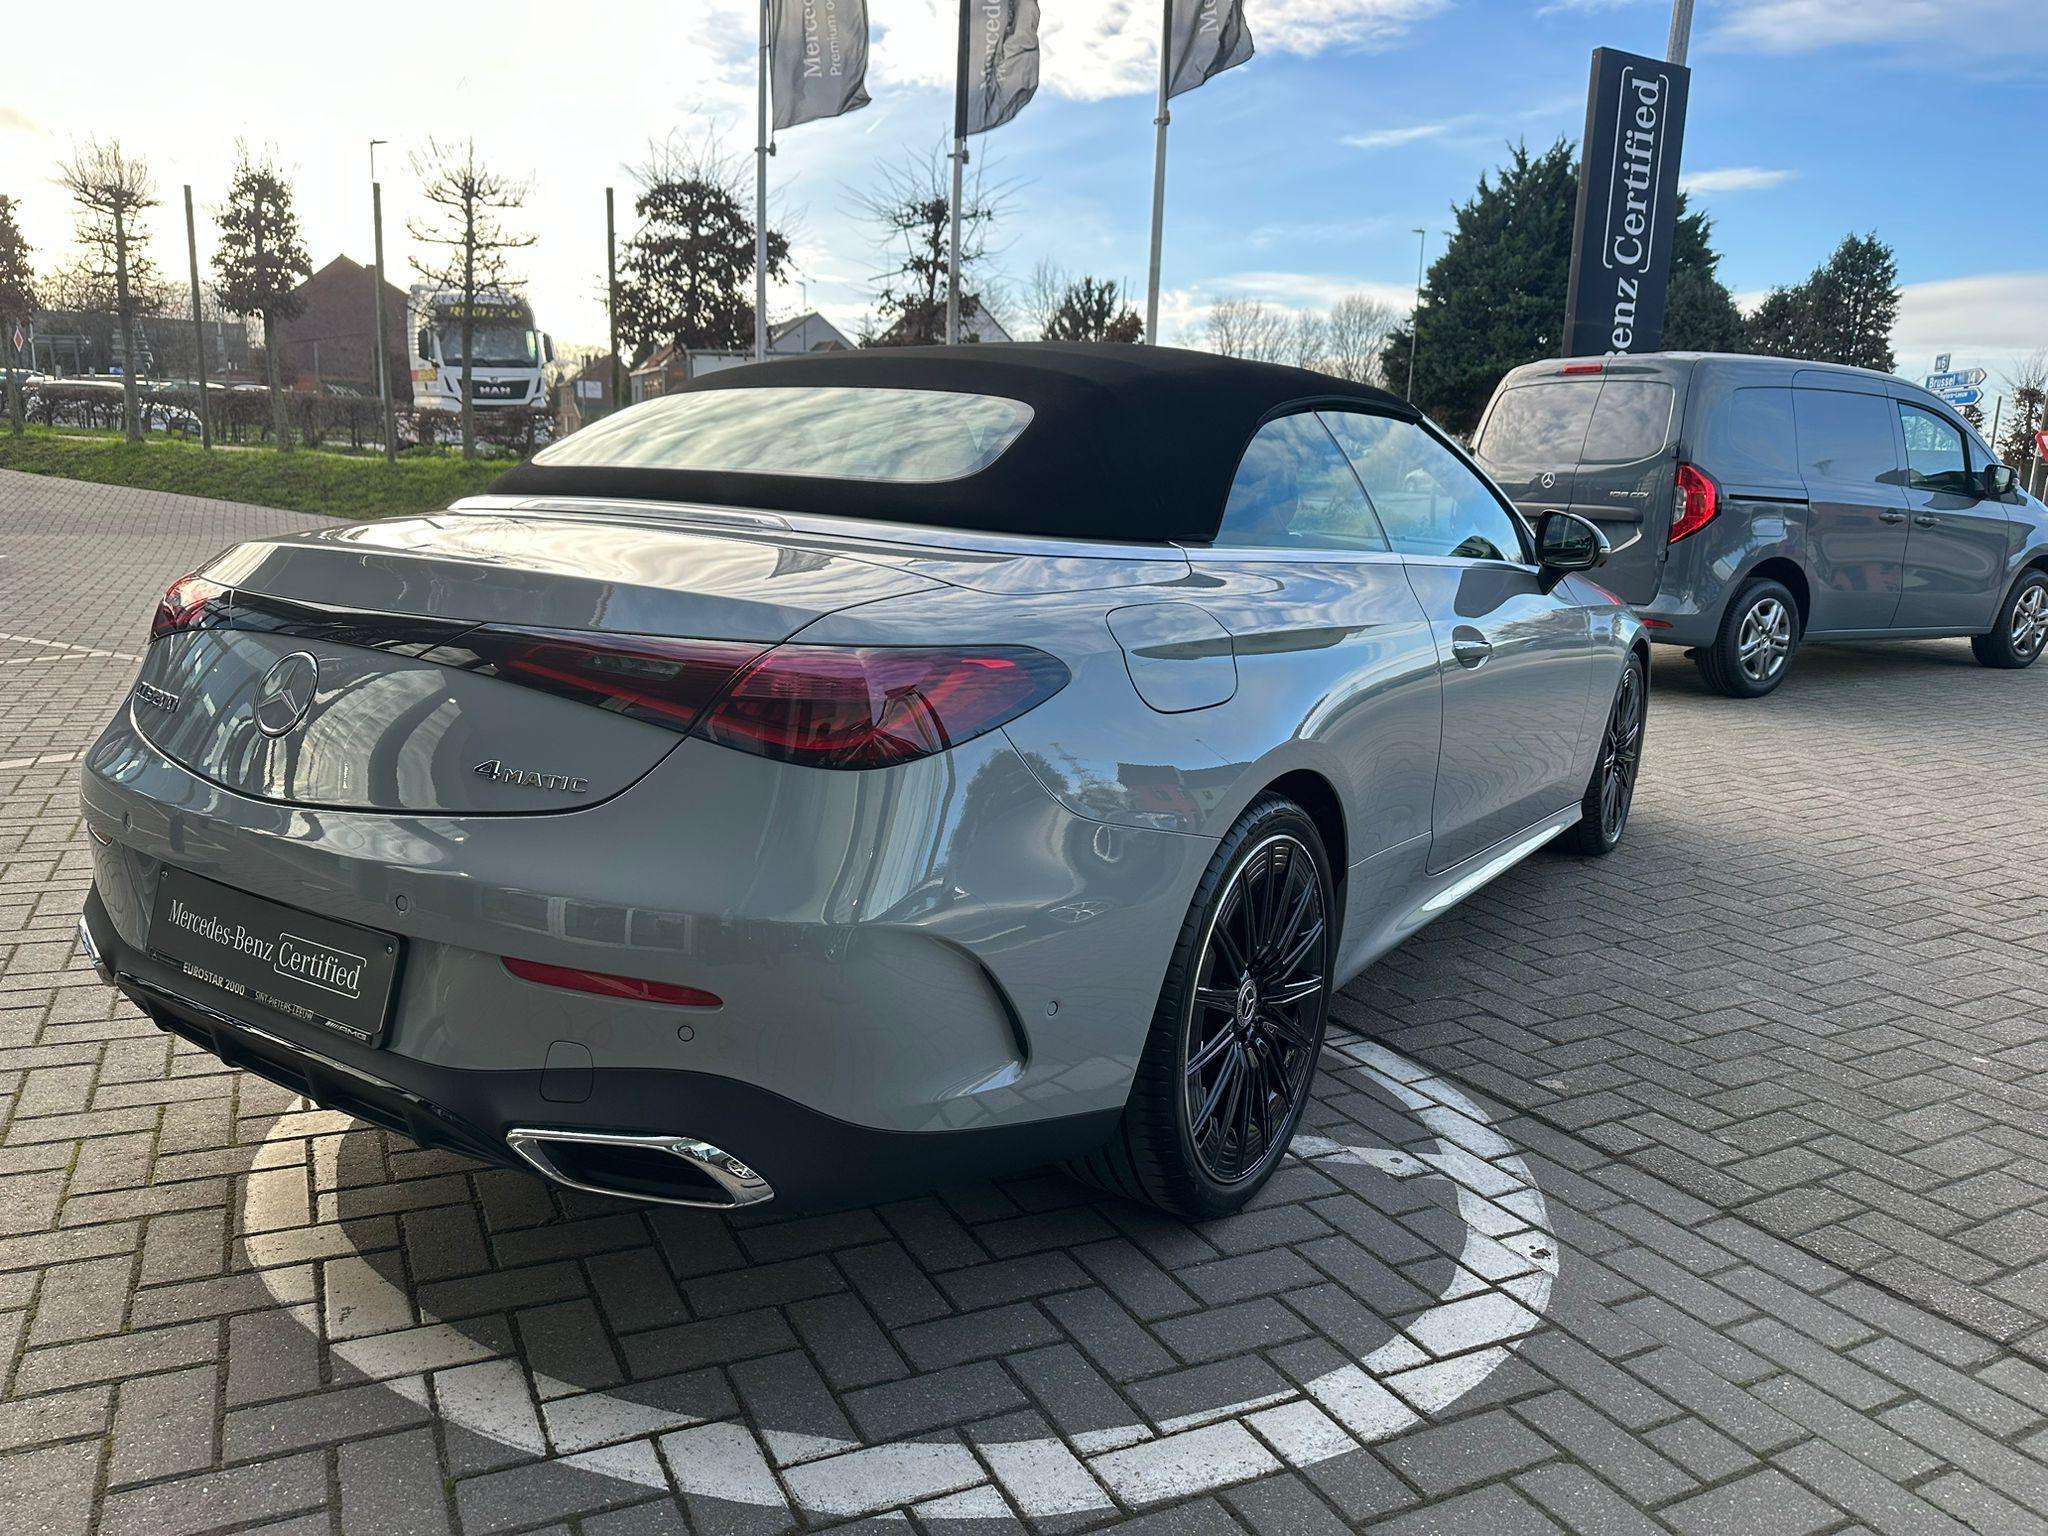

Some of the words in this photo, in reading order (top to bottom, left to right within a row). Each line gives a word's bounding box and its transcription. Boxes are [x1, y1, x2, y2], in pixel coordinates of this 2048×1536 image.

[828, 15, 842, 76] Premium
[1613, 77, 1661, 266] Certified
[1604, 276, 1639, 356] enz
[479, 386, 511, 395] MAN
[1929, 375, 1955, 389] Brussel
[473, 760, 588, 792] 4MATIC
[168, 899, 274, 962] Mercedes-Benz
[278, 941, 361, 990] Certified
[183, 962, 223, 988] EUROSTAR
[224, 978, 245, 996] 2000
[339, 1025, 368, 1041] AMG
